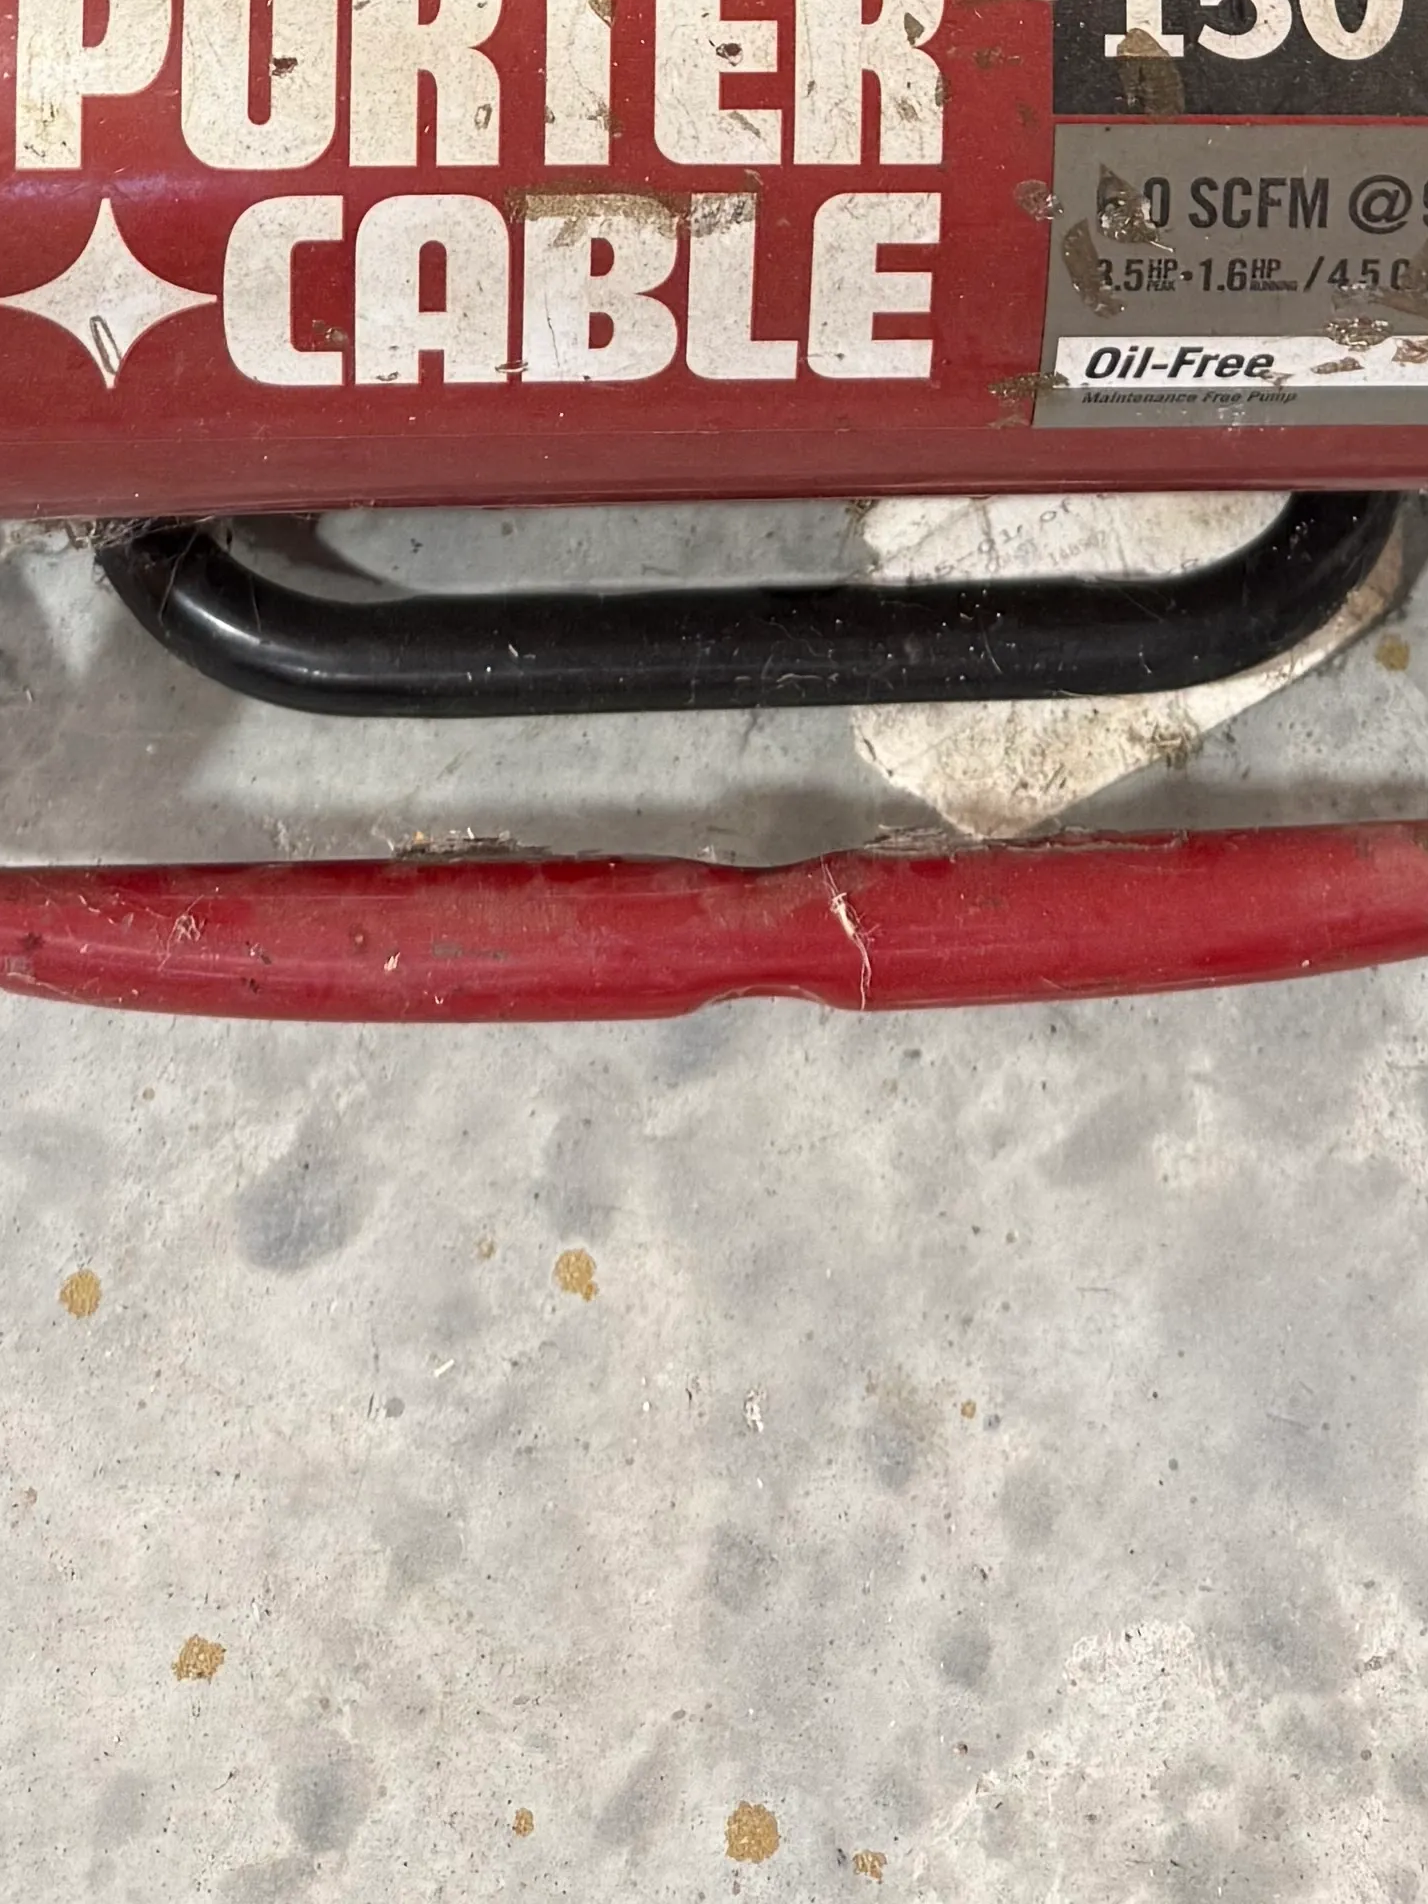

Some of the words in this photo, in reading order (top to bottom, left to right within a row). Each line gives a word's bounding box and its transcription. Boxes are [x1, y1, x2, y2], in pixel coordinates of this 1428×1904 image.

[1188, 176, 1329, 229] SCFM
[222, 192, 942, 387] CABLE
[1085, 345, 1275, 379] Oil-Free
[1081, 391, 1198, 404] Maintenance
[1201, 390, 1242, 403] Free
[1246, 390, 1299, 405] Pump
